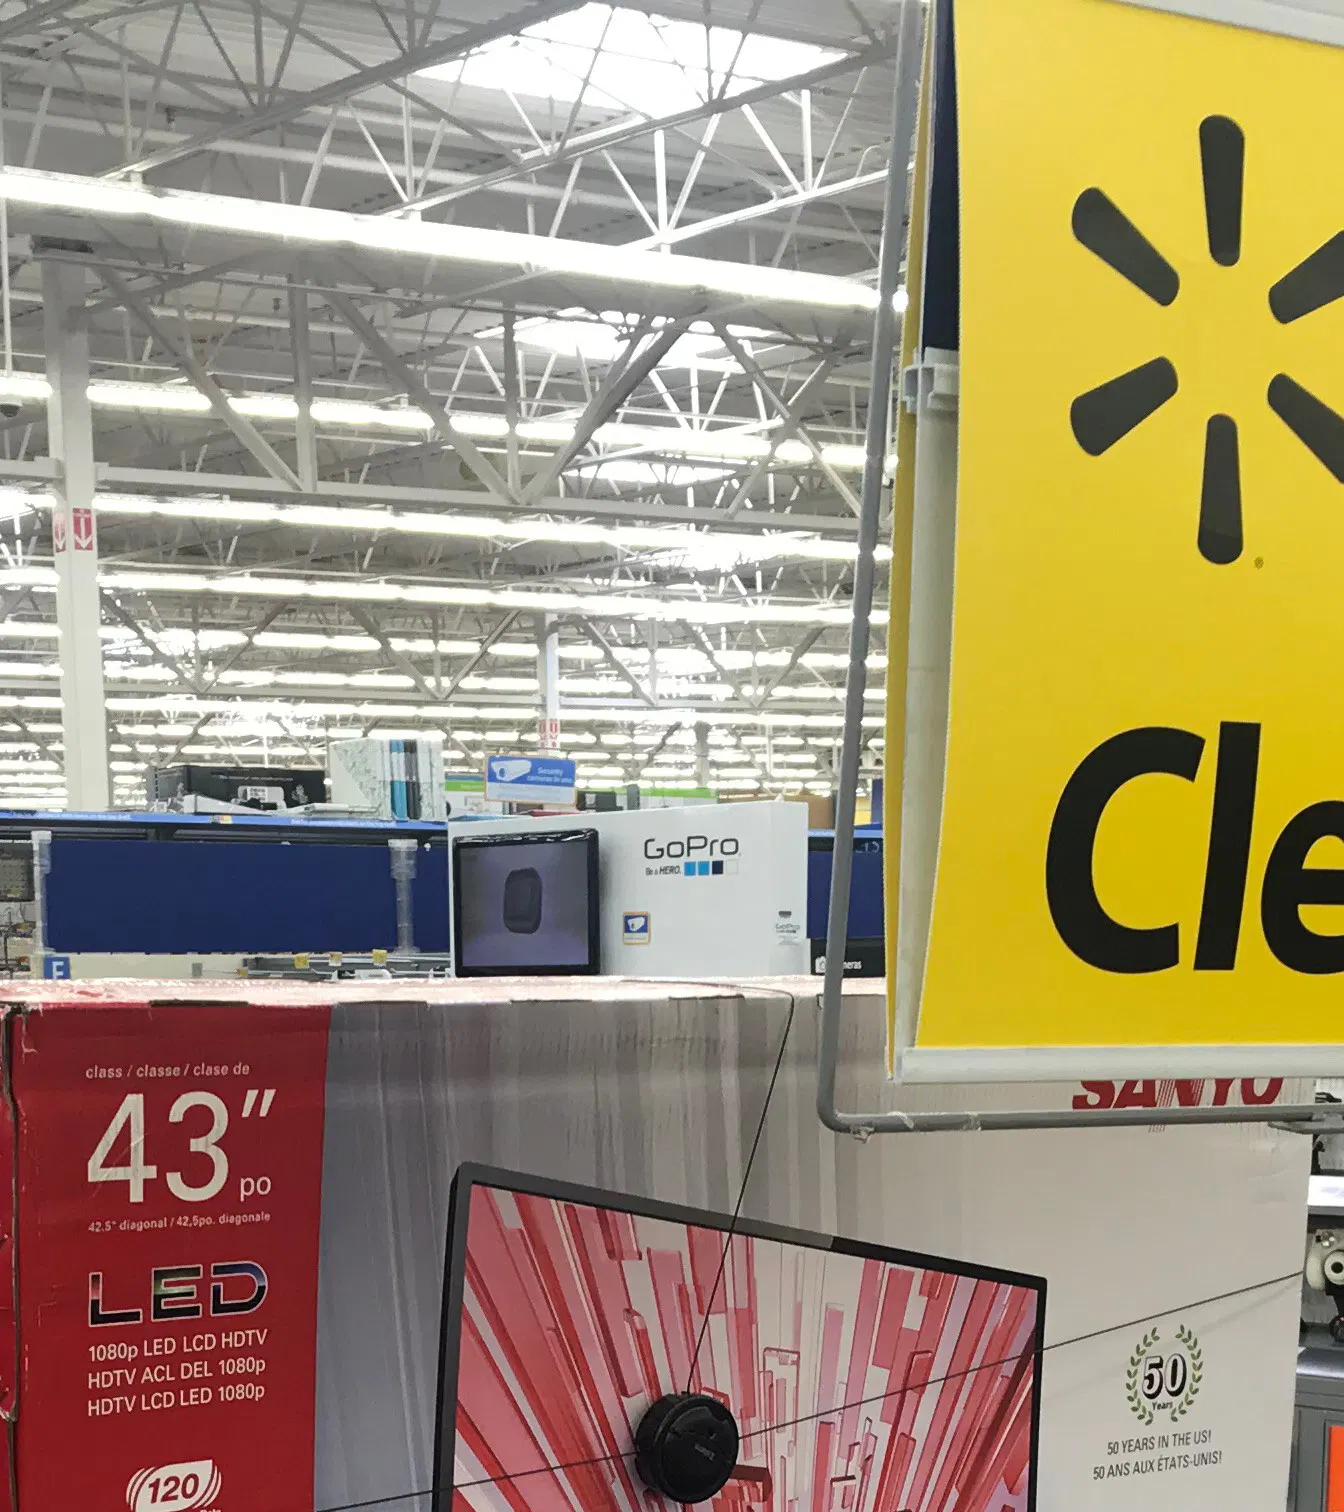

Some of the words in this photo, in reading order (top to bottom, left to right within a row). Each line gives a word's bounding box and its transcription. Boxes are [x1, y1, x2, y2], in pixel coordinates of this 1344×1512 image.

[643, 834, 740, 860] GoPro
[85, 1064, 123, 1079] class
[136, 1064, 181, 1078] classe
[193, 1062, 229, 1076] clase
[1071, 1078, 1285, 1111] SANYO
[87, 1088, 277, 1203] 43"
[240, 1176, 272, 1202] po
[119, 1217, 168, 1232] diagonal
[218, 1211, 271, 1227] diagonale
[88, 1260, 269, 1328] LED
[89, 1342, 139, 1362] 1080p
[143, 1337, 177, 1356] LED
[182, 1333, 216, 1353] LCD
[221, 1328, 268, 1349] HDTV
[88, 1367, 137, 1389] HDTV
[140, 1364, 175, 1384] ACL
[180, 1360, 213, 1380] DEL
[218, 1356, 266, 1376] 1080p
[1142, 1353, 1187, 1400] 50
[87, 1394, 136, 1417] HDTV
[141, 1391, 175, 1411] LCD
[180, 1387, 213, 1406] LED
[217, 1382, 265, 1402] 1080p
[1107, 1441, 1119, 1456] 50
[1121, 1436, 1156, 1454] YEARS
[1158, 1434, 1169, 1449] IN
[1172, 1432, 1191, 1448] THE
[1093, 1466, 1105, 1481] 50
[1106, 1462, 1130, 1479] ANS
[1133, 1459, 1155, 1475] AUX
[1157, 1450, 1223, 1473] ÉTATS-UNIS!
[147, 1472, 200, 1504] 120
